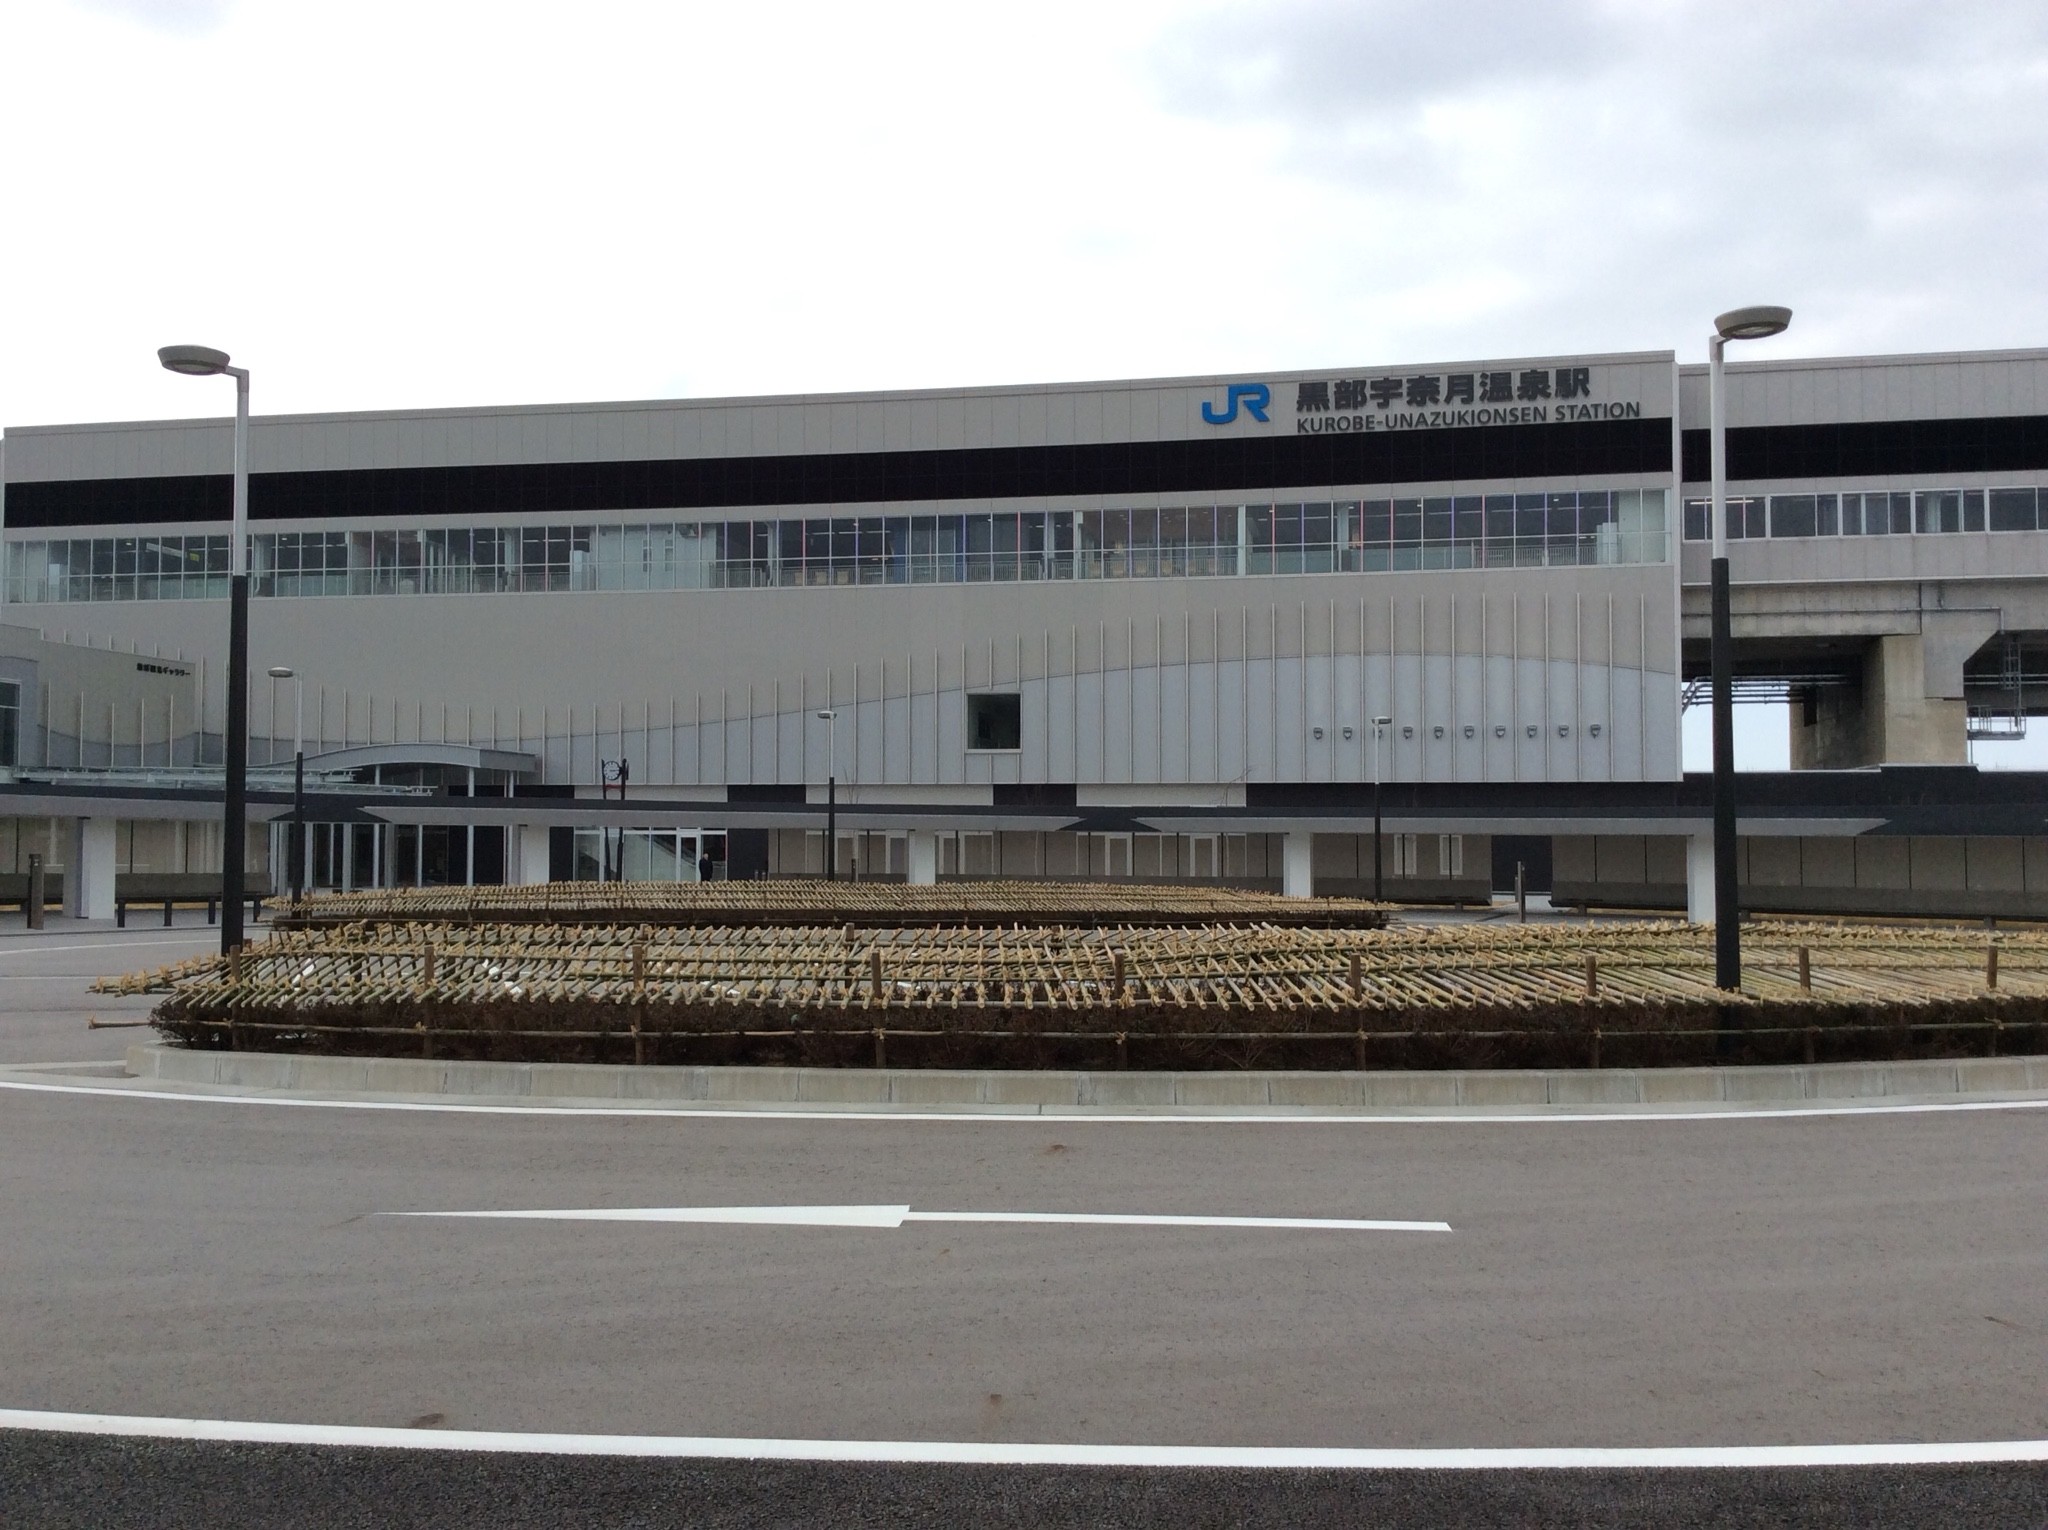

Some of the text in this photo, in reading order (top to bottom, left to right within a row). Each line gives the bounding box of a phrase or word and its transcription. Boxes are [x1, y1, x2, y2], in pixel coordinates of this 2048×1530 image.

[1202, 384, 1271, 425] JR
[1296, 367, 1590, 412] 黒部宇奈月温泉駅
[1297, 401, 1641, 433] KUROBE-UNAZUKIONSEN STATION
